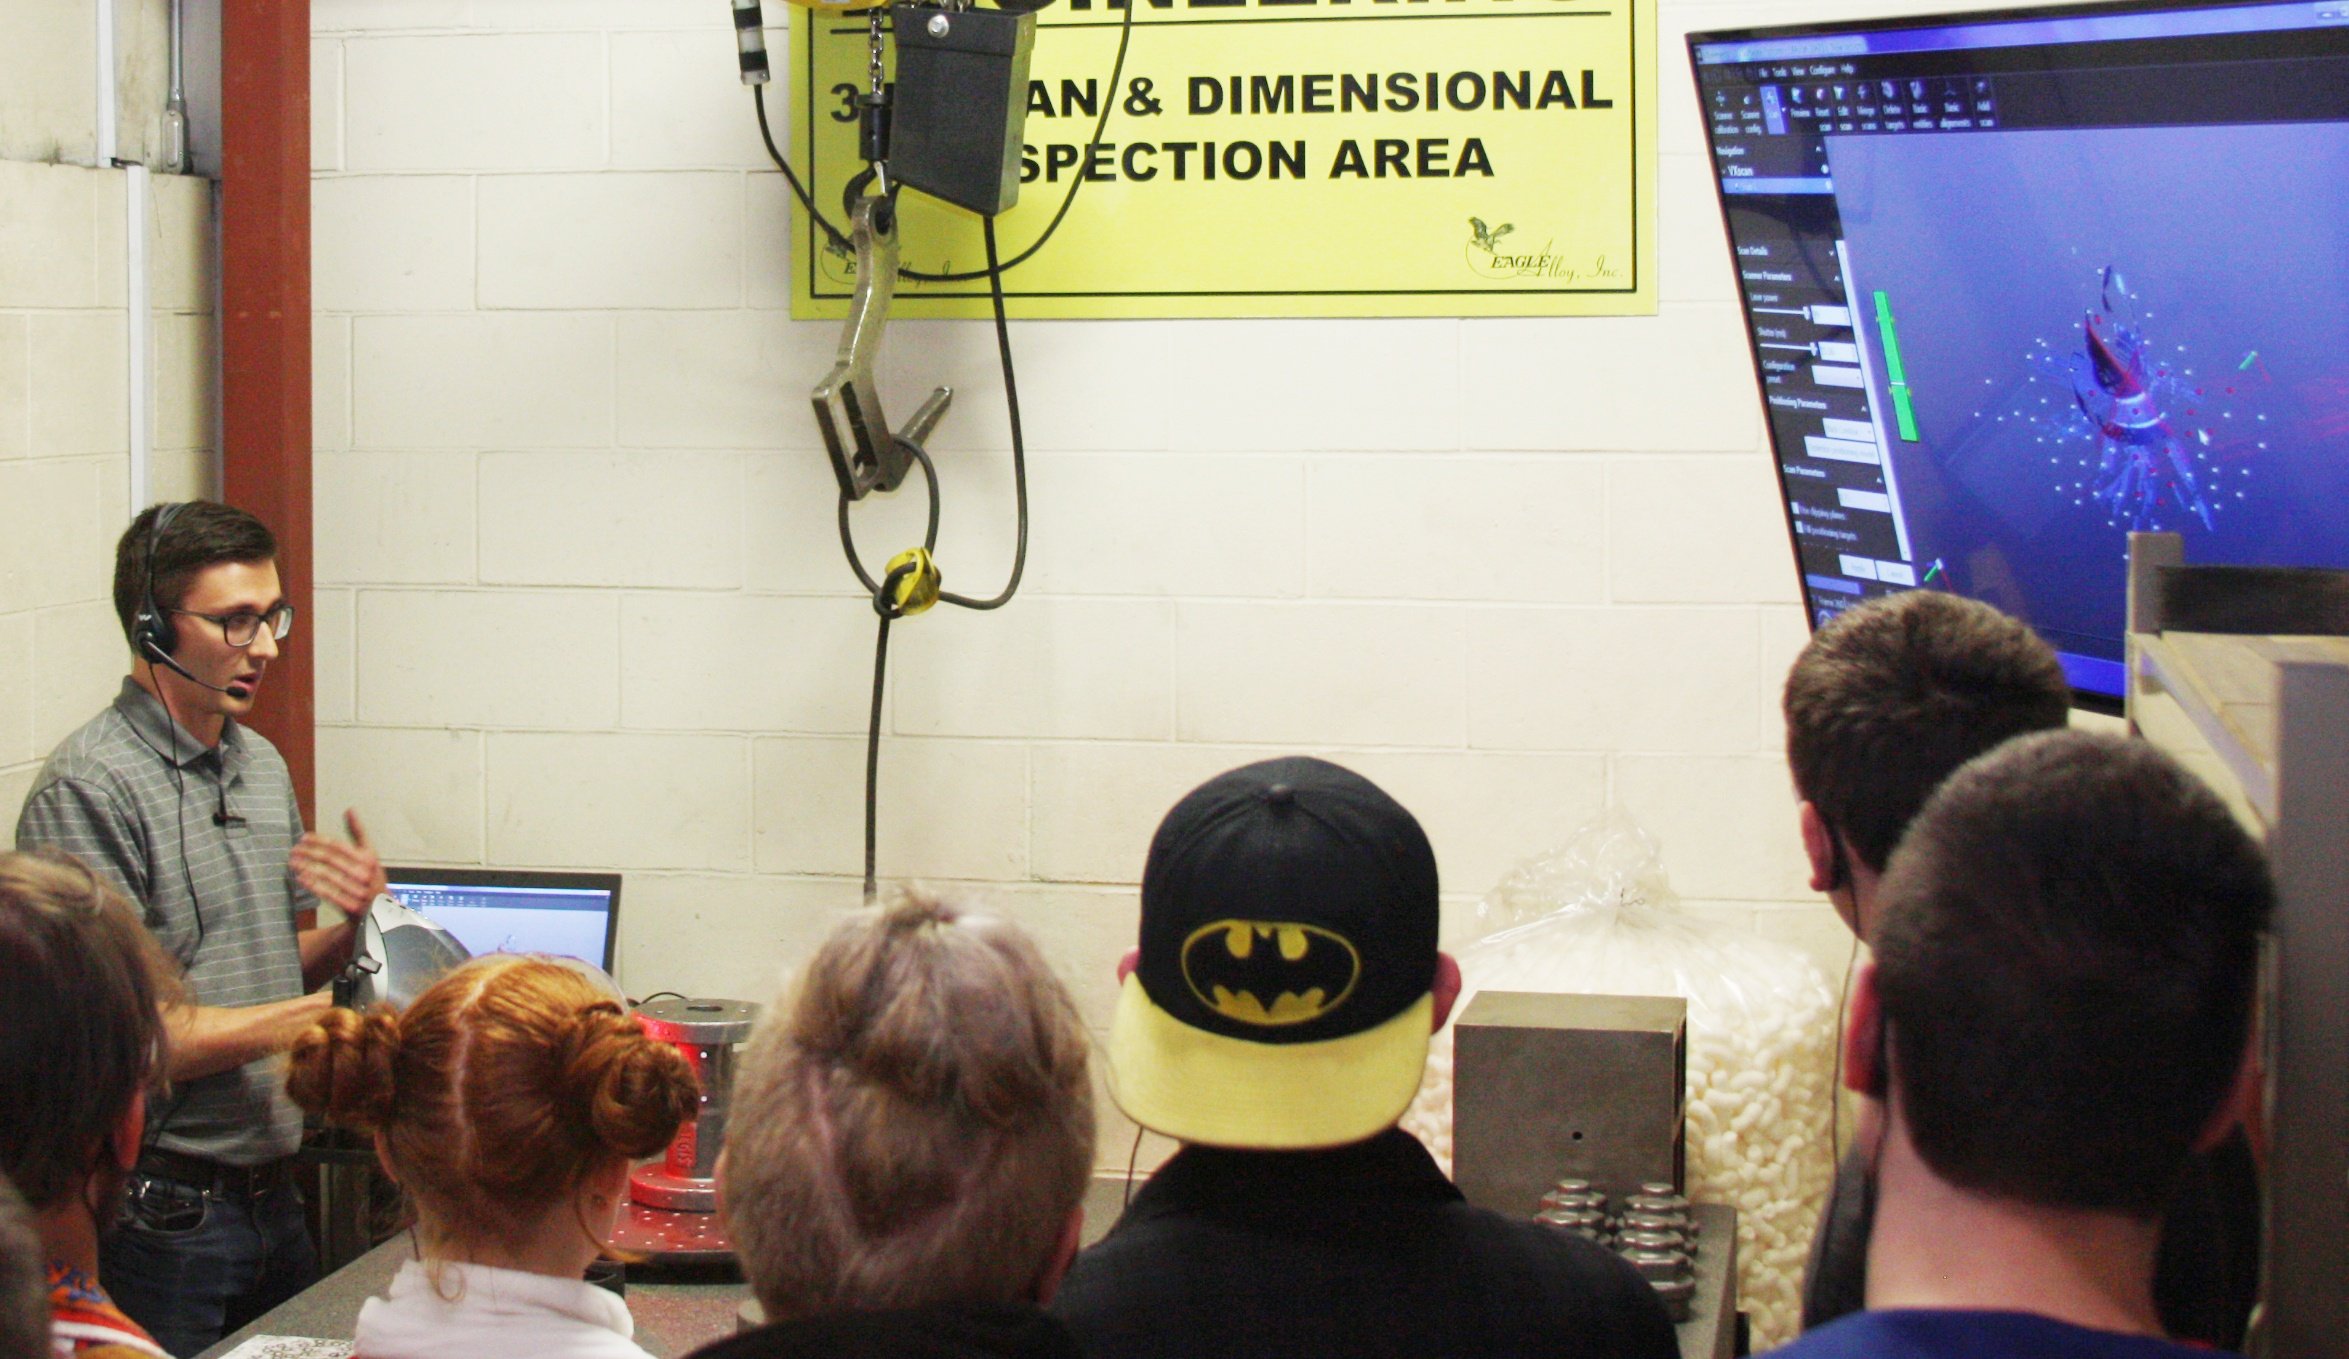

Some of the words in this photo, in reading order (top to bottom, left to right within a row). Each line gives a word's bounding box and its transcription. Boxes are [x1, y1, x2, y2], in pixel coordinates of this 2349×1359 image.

[1024, 79, 1098, 118] AN
[1122, 76, 1162, 117] &
[1188, 69, 1613, 116] DIMENSIONAL
[1019, 139, 1306, 183] SPECTION
[1328, 137, 1495, 179] AREA
[1491, 255, 1551, 269] EAGLE
[1587, 254, 1623, 278] Inc.
